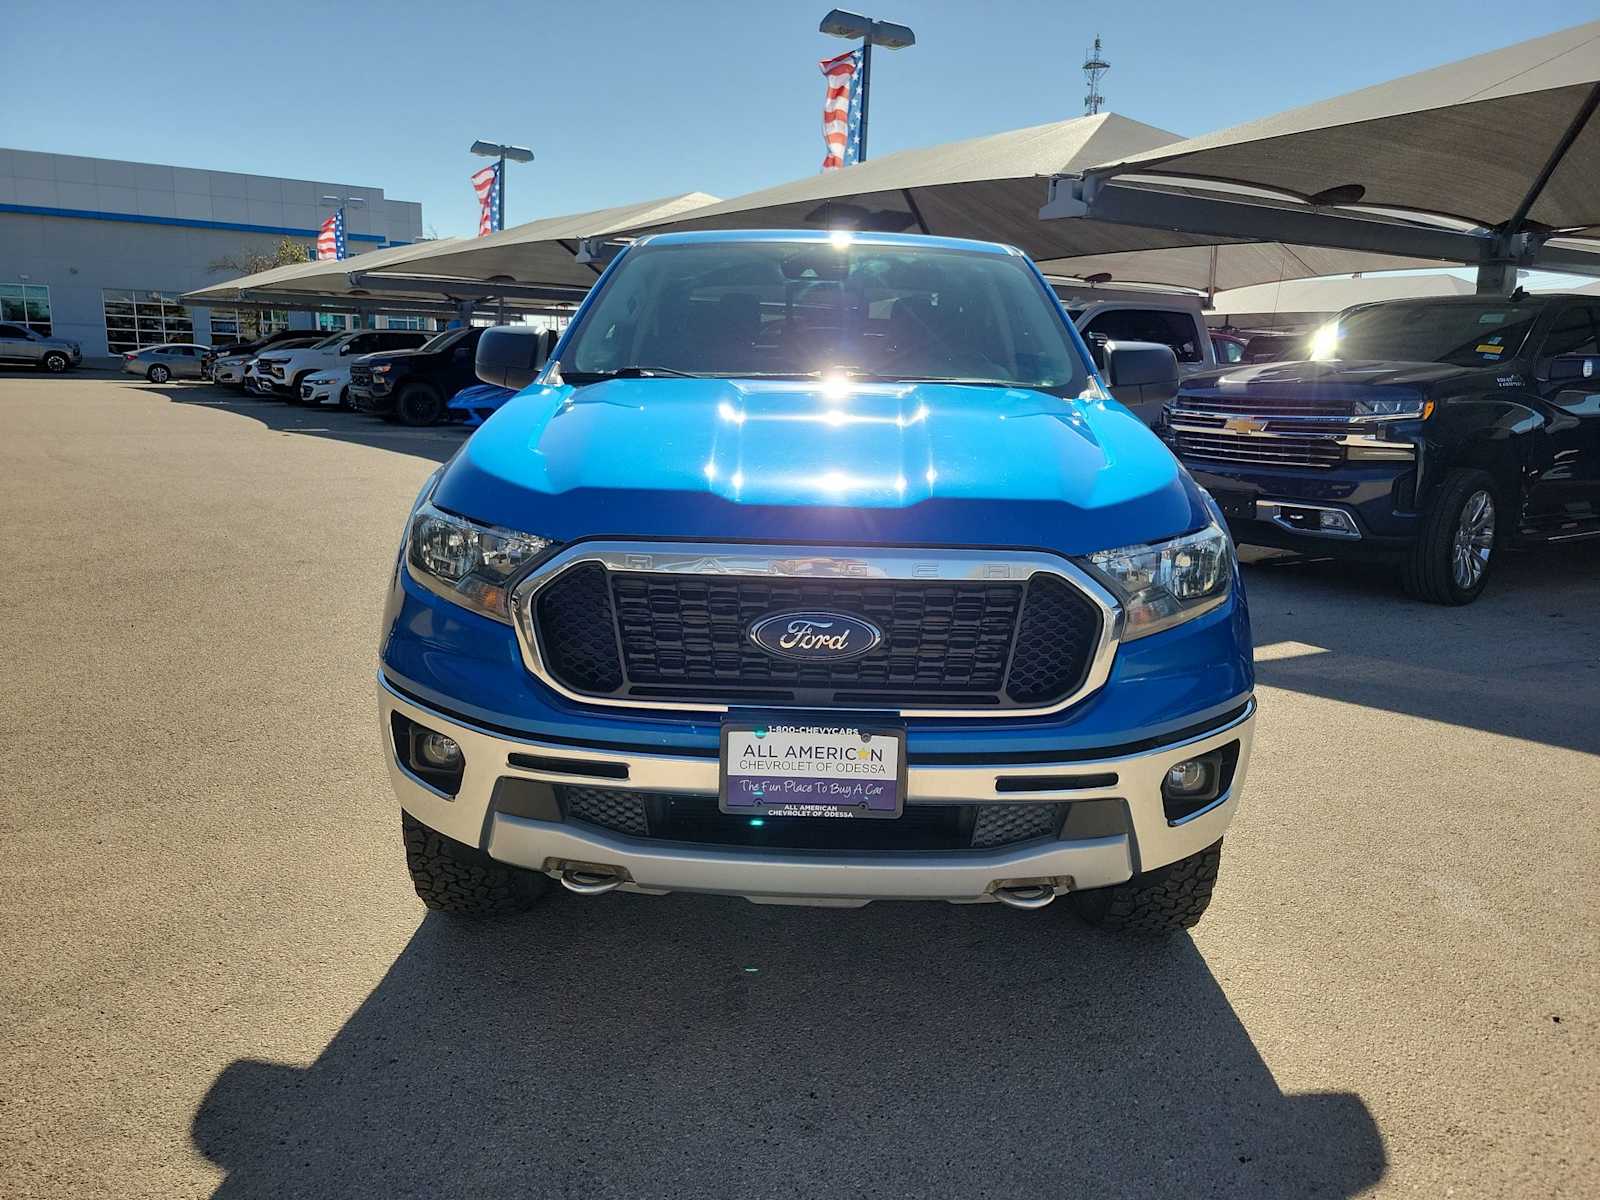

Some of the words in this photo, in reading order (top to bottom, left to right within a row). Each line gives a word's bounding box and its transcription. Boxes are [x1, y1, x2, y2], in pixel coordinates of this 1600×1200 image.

[625, 553, 1011, 578] RANGER
[780, 620, 850, 650] Ford
[767, 725, 859, 735] 1-800-CHEVYCARS
[743, 744, 778, 758] ALL
[785, 746, 882, 762] AMERICN
[739, 760, 812, 772] CHEVROLET
[816, 762, 832, 773] OF
[836, 763, 886, 774] ODESSA
[740, 779, 759, 792] The
[761, 781, 781, 793] Fun
[783, 780, 812, 793] Place
[815, 782, 827, 794] To
[830, 784, 852, 798] Buy
[853, 785, 863, 795] A
[865, 785, 884, 796] Car
[800, 804, 838, 812] AMERICAN
